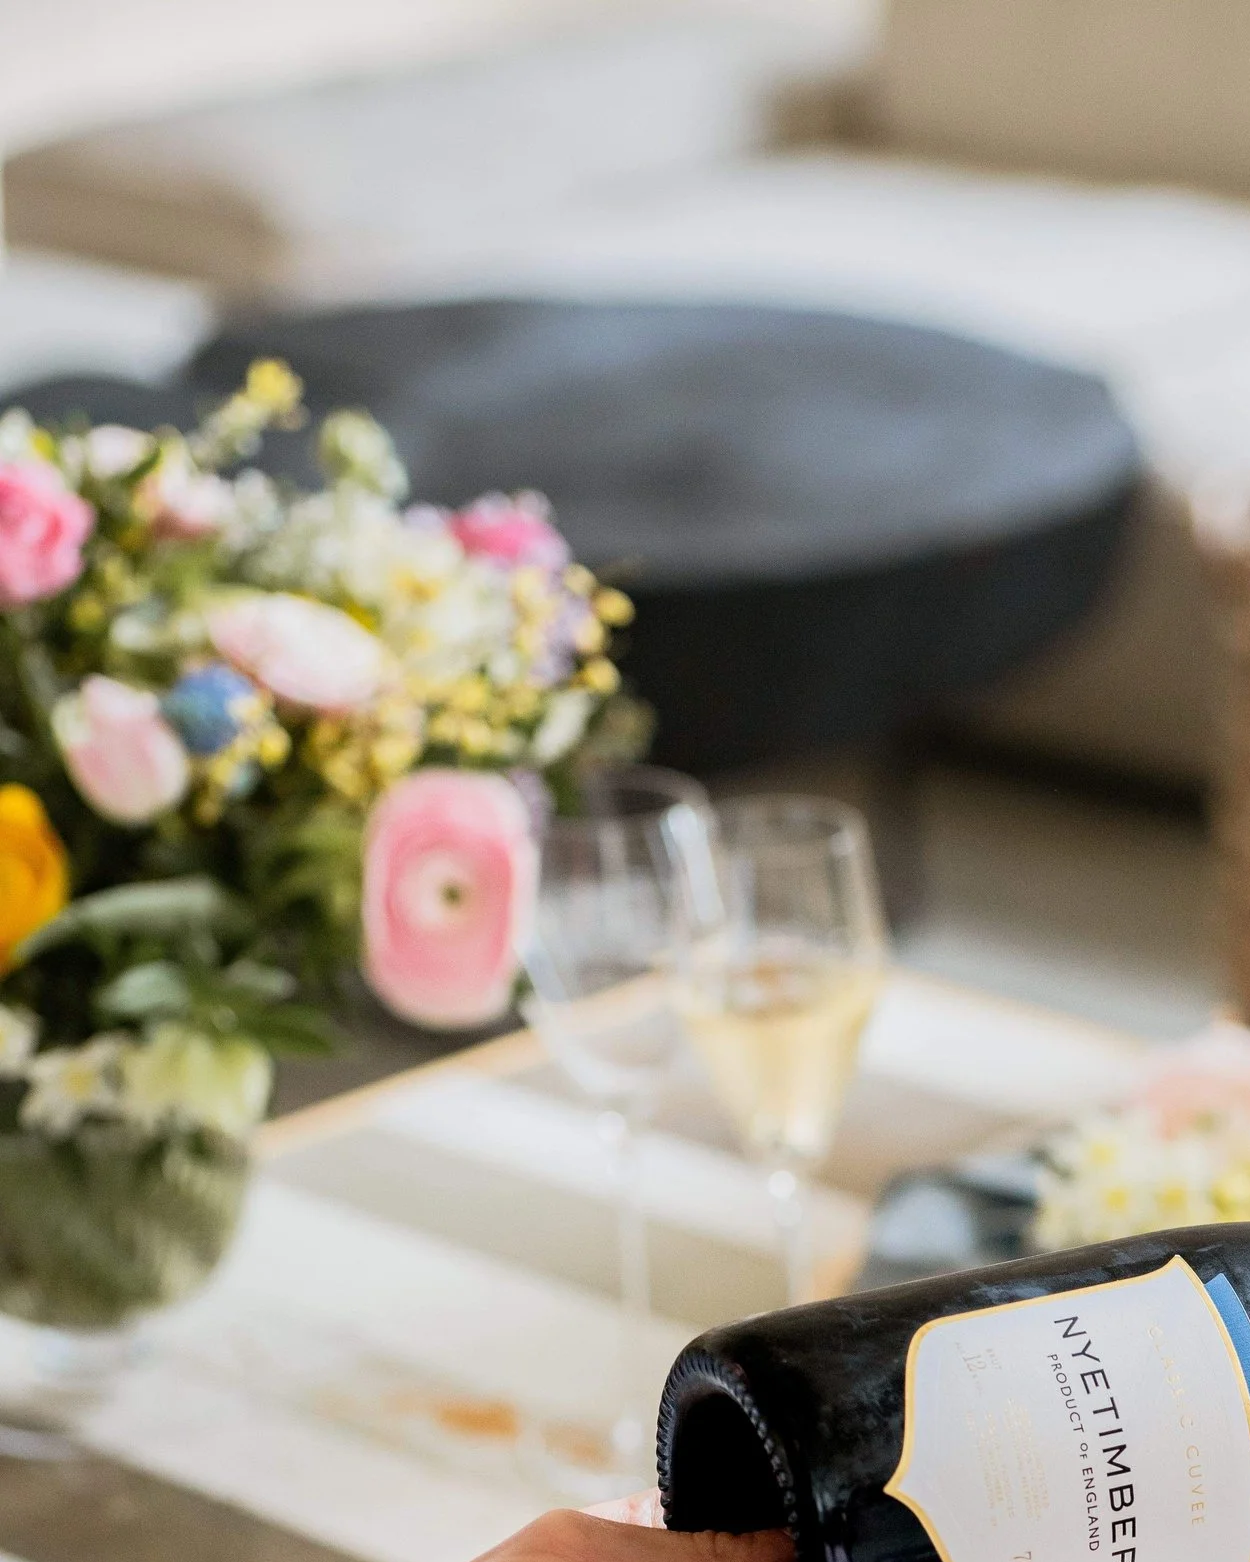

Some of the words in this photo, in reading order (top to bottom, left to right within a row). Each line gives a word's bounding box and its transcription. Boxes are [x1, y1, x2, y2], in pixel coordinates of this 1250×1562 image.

[1047, 1353, 1085, 1433] PRODUCT
[1079, 1442, 1088, 1459] OF
[1186, 1445, 1206, 1526] CUVEE
[1082, 1467, 1100, 1551] ENGLAND
